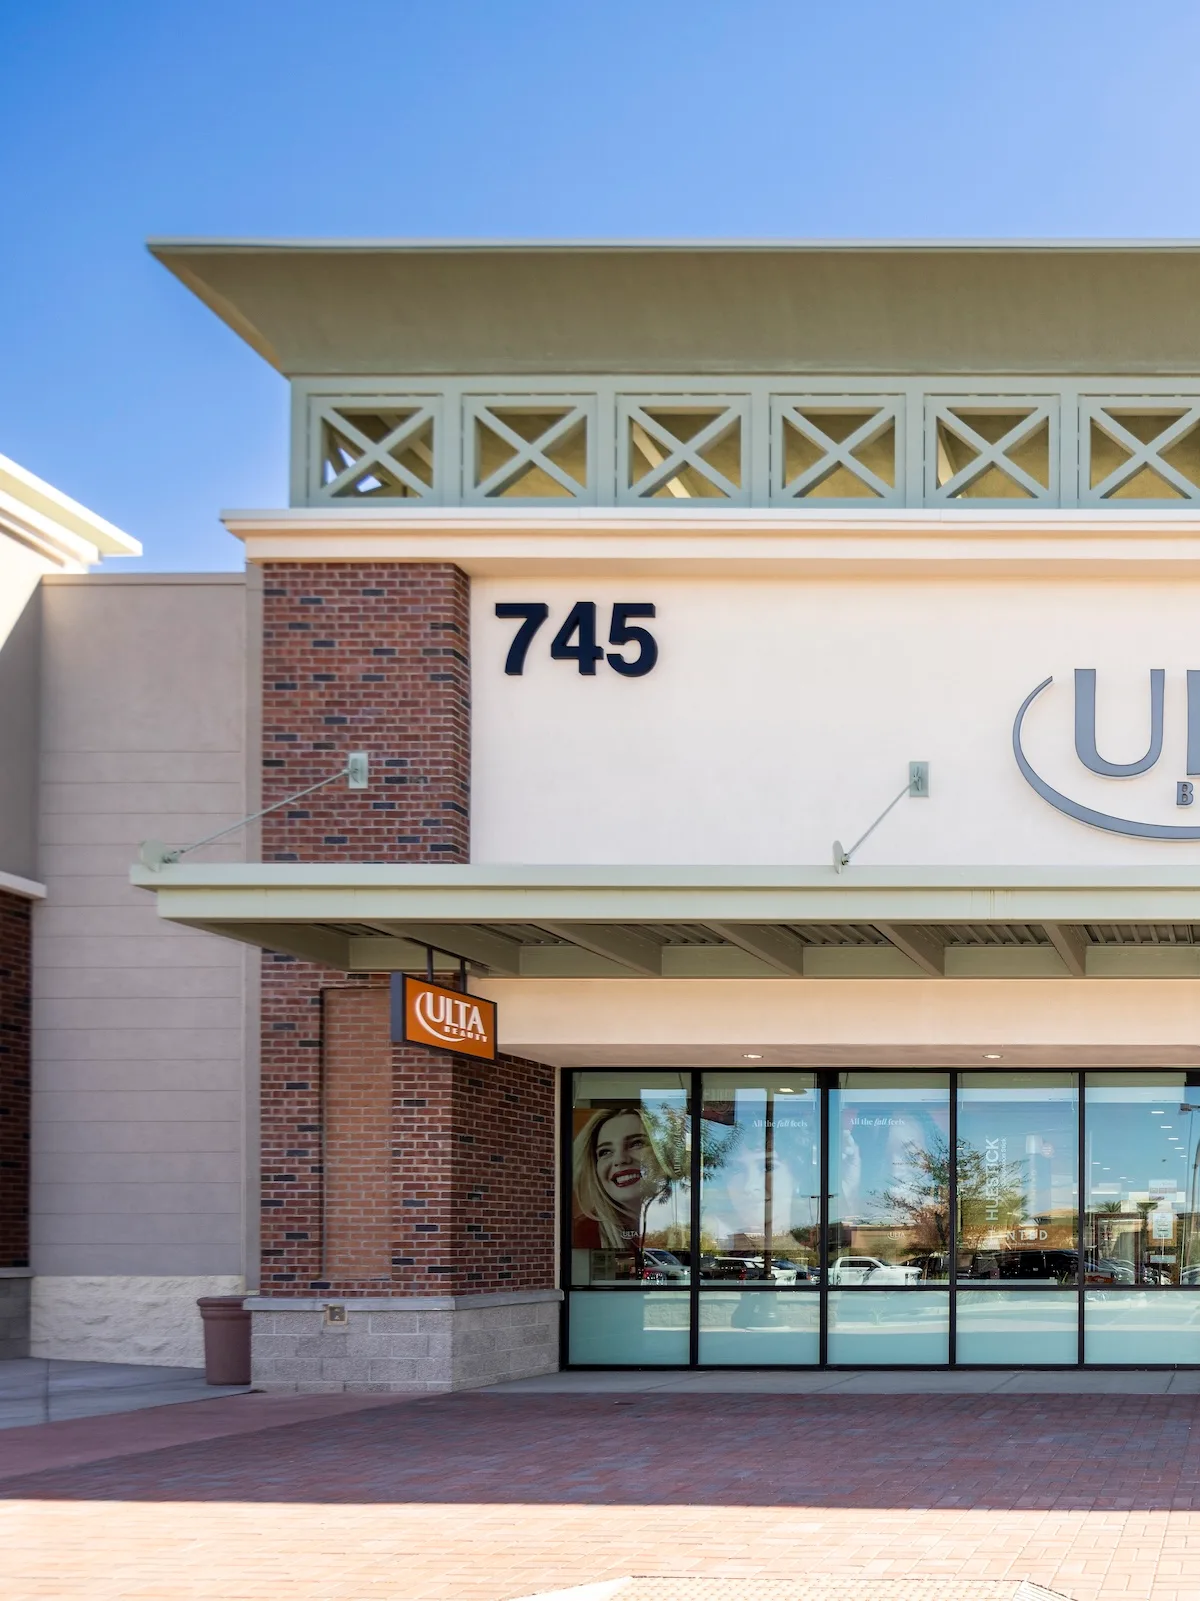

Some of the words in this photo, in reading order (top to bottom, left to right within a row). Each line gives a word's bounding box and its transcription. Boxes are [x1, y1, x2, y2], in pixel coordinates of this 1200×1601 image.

[495, 601, 659, 678] 745
[426, 991, 486, 1035] ULTA
[443, 1026, 488, 1043] BEAUTY
[752, 1120, 762, 1128] All
[850, 1118, 860, 1126] All
[861, 1118, 873, 1126] the
[985, 1138, 999, 1221] HUESTICK
